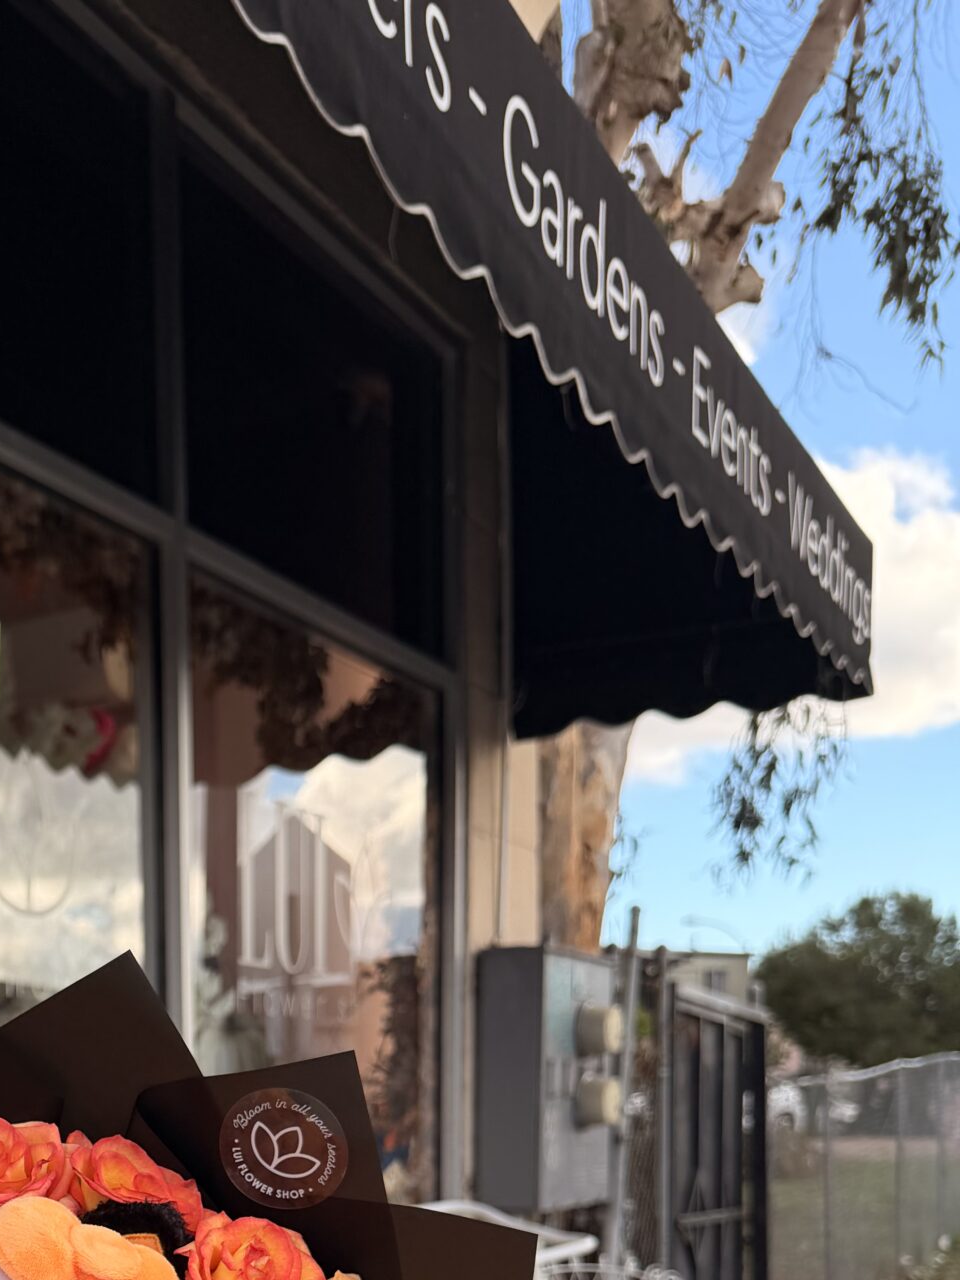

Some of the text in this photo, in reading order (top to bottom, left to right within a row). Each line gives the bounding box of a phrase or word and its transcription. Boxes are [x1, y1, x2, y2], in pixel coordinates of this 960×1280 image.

[502, 94, 666, 387] Gardens
[691, 345, 772, 517] Events
[788, 470, 872, 646] Weddings
[236, 790, 328, 979] LUI
[231, 1147, 305, 1200] LUI FLOWER SHOP
[232, 1099, 337, 1186] Bloom in all your seasons
